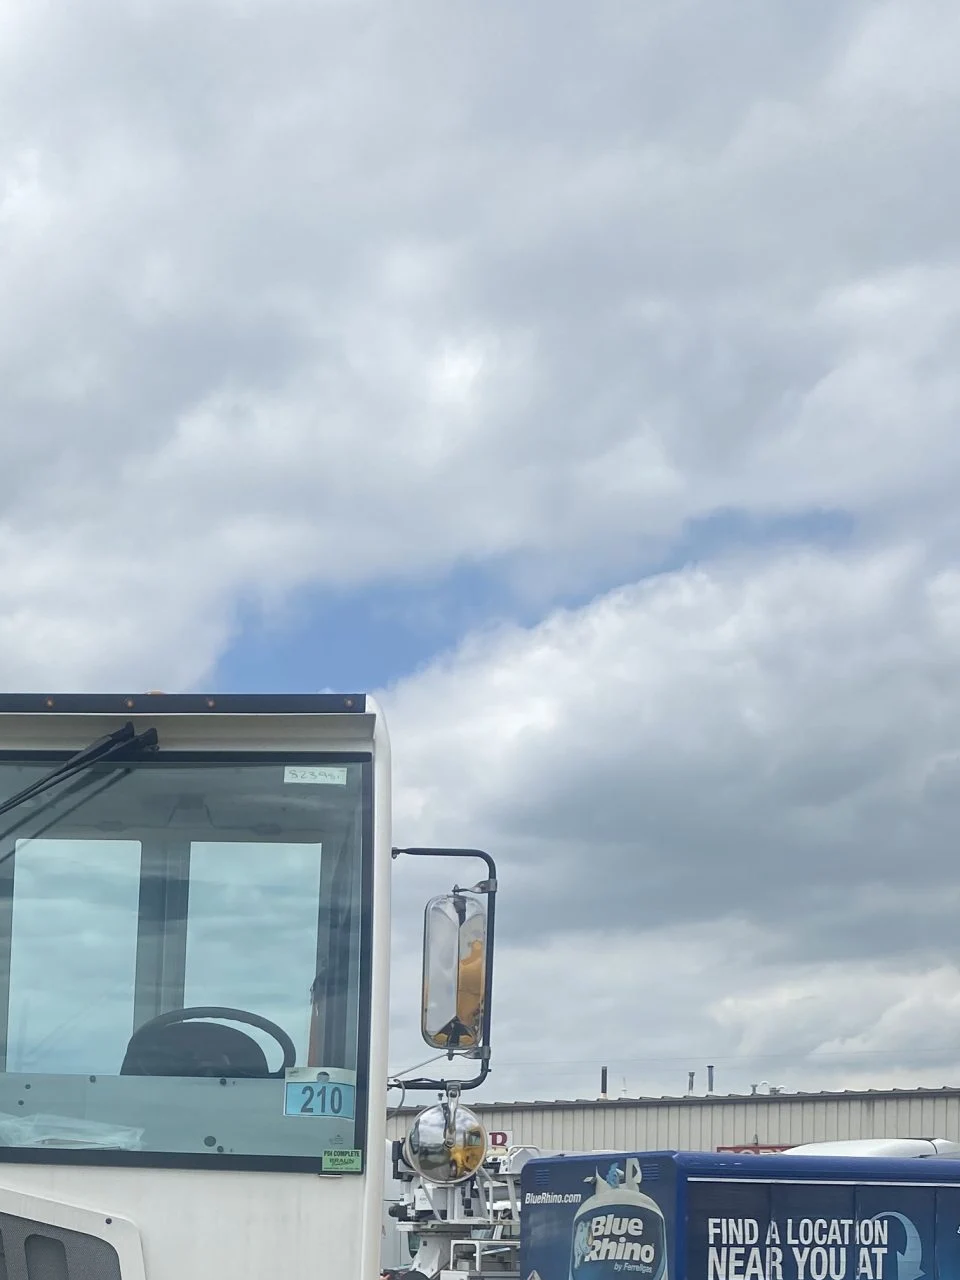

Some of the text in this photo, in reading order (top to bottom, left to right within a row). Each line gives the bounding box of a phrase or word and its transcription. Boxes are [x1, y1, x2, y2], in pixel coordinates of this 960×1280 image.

[300, 1085, 343, 1114] 210
[525, 1192, 581, 1204] BlueRhino.com
[591, 1213, 643, 1236] Blue
[707, 1217, 888, 1245] FIND A LOCATION
[584, 1236, 655, 1263] Rhino
[707, 1246, 888, 1280] NEAR YOU AT
[613, 1262, 622, 1272] by
